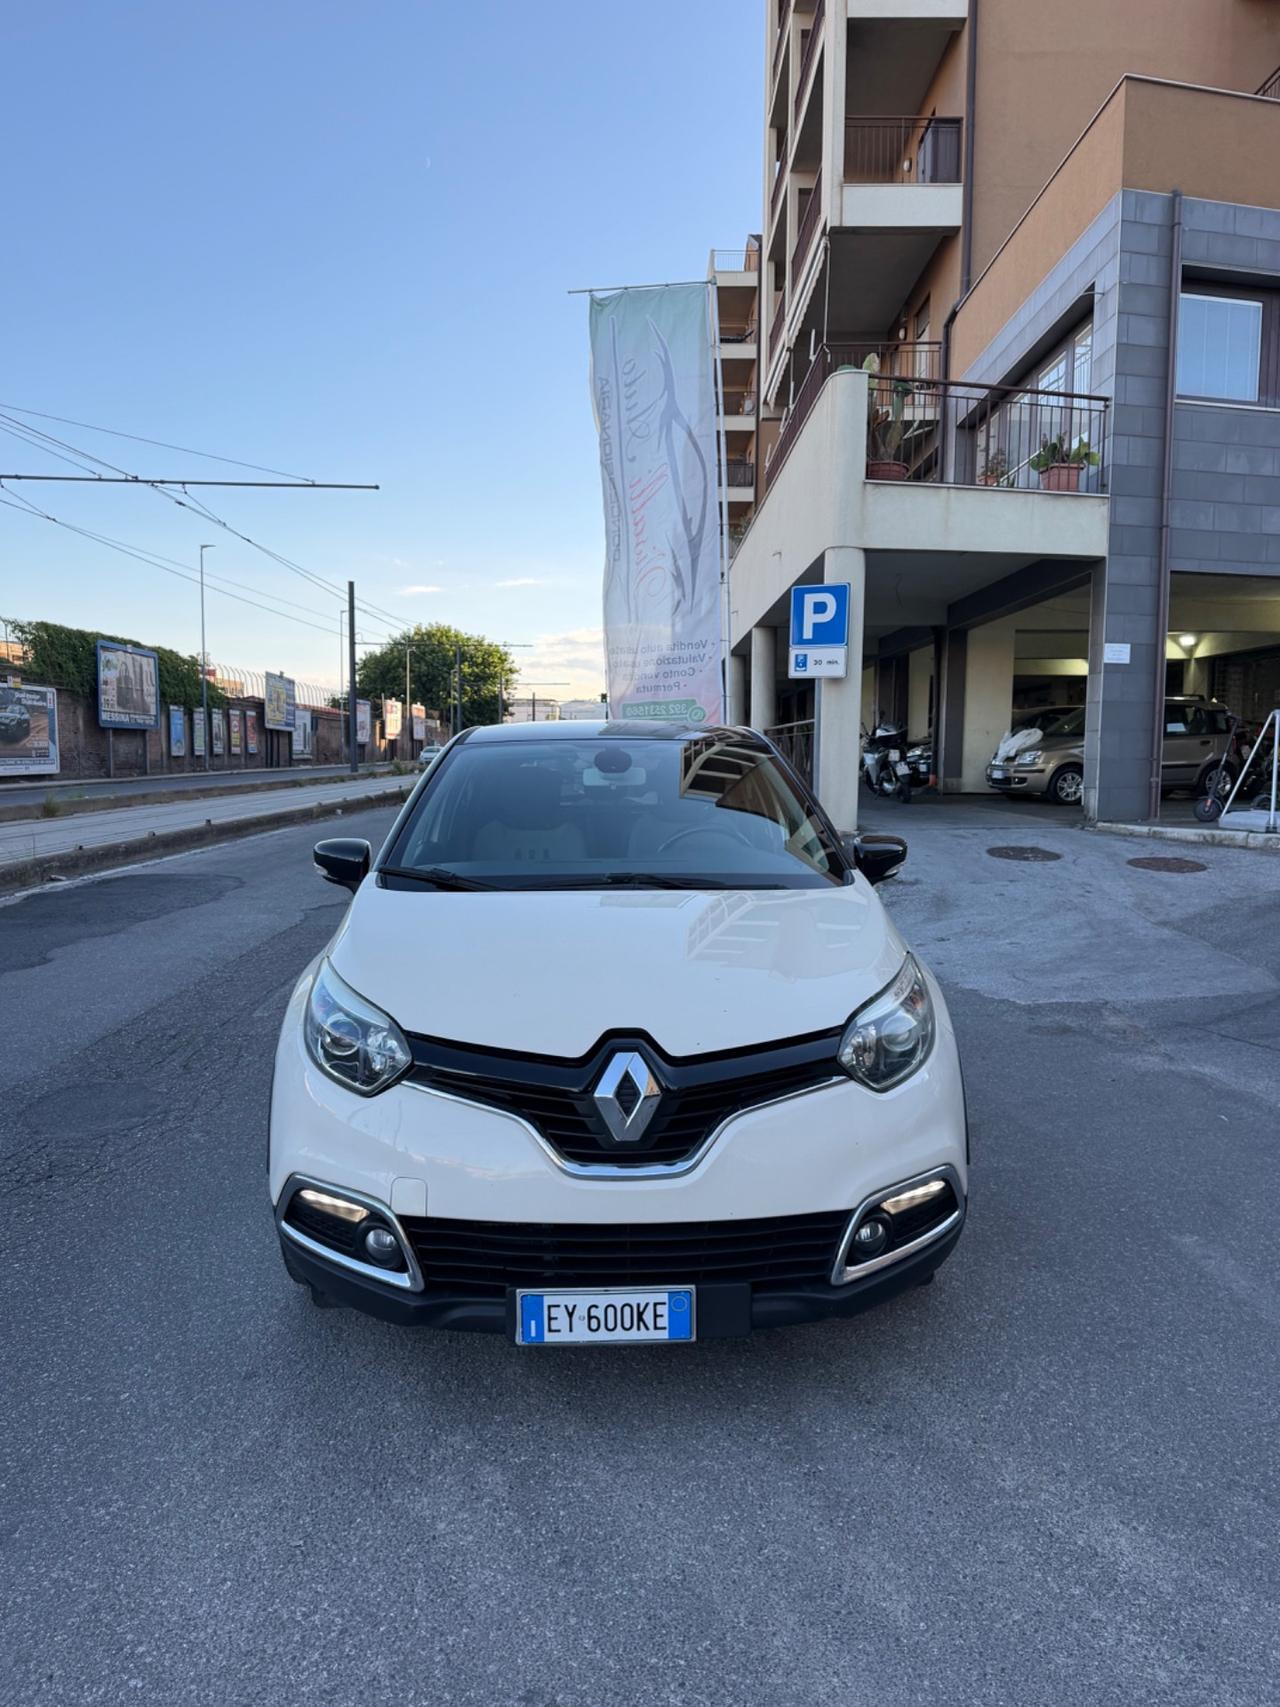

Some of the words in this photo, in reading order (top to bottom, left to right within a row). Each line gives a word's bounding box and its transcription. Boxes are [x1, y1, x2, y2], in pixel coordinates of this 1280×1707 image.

[802, 592, 837, 640] P
[547, 1304, 577, 1333] EY
[586, 1302, 667, 1332] 600KE
